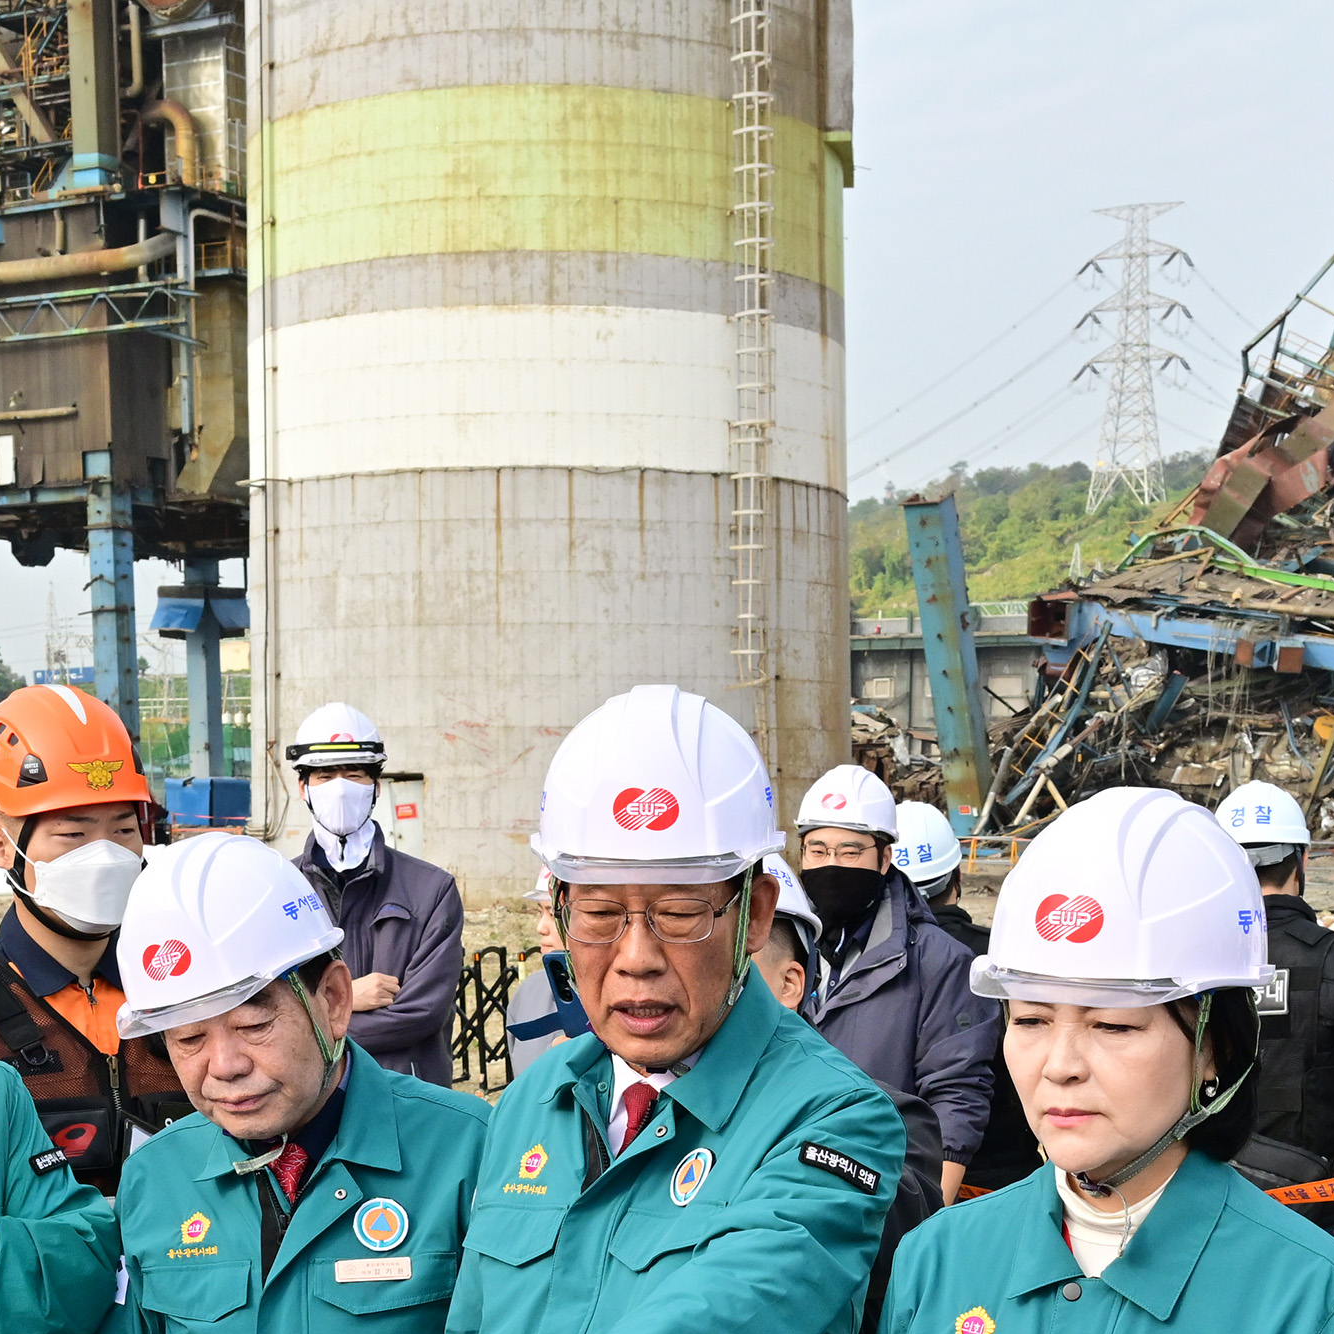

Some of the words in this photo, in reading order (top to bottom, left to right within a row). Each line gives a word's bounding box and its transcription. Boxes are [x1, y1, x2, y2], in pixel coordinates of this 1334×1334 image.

[23, 762, 39, 770] VERTEX
[1230, 804, 1273, 828] 경찰
[894, 842, 933, 867] 경찰
[281, 892, 324, 921] 동서발
[805, 1145, 858, 1179] 울산광역시
[857, 1168, 877, 1190] 의회
